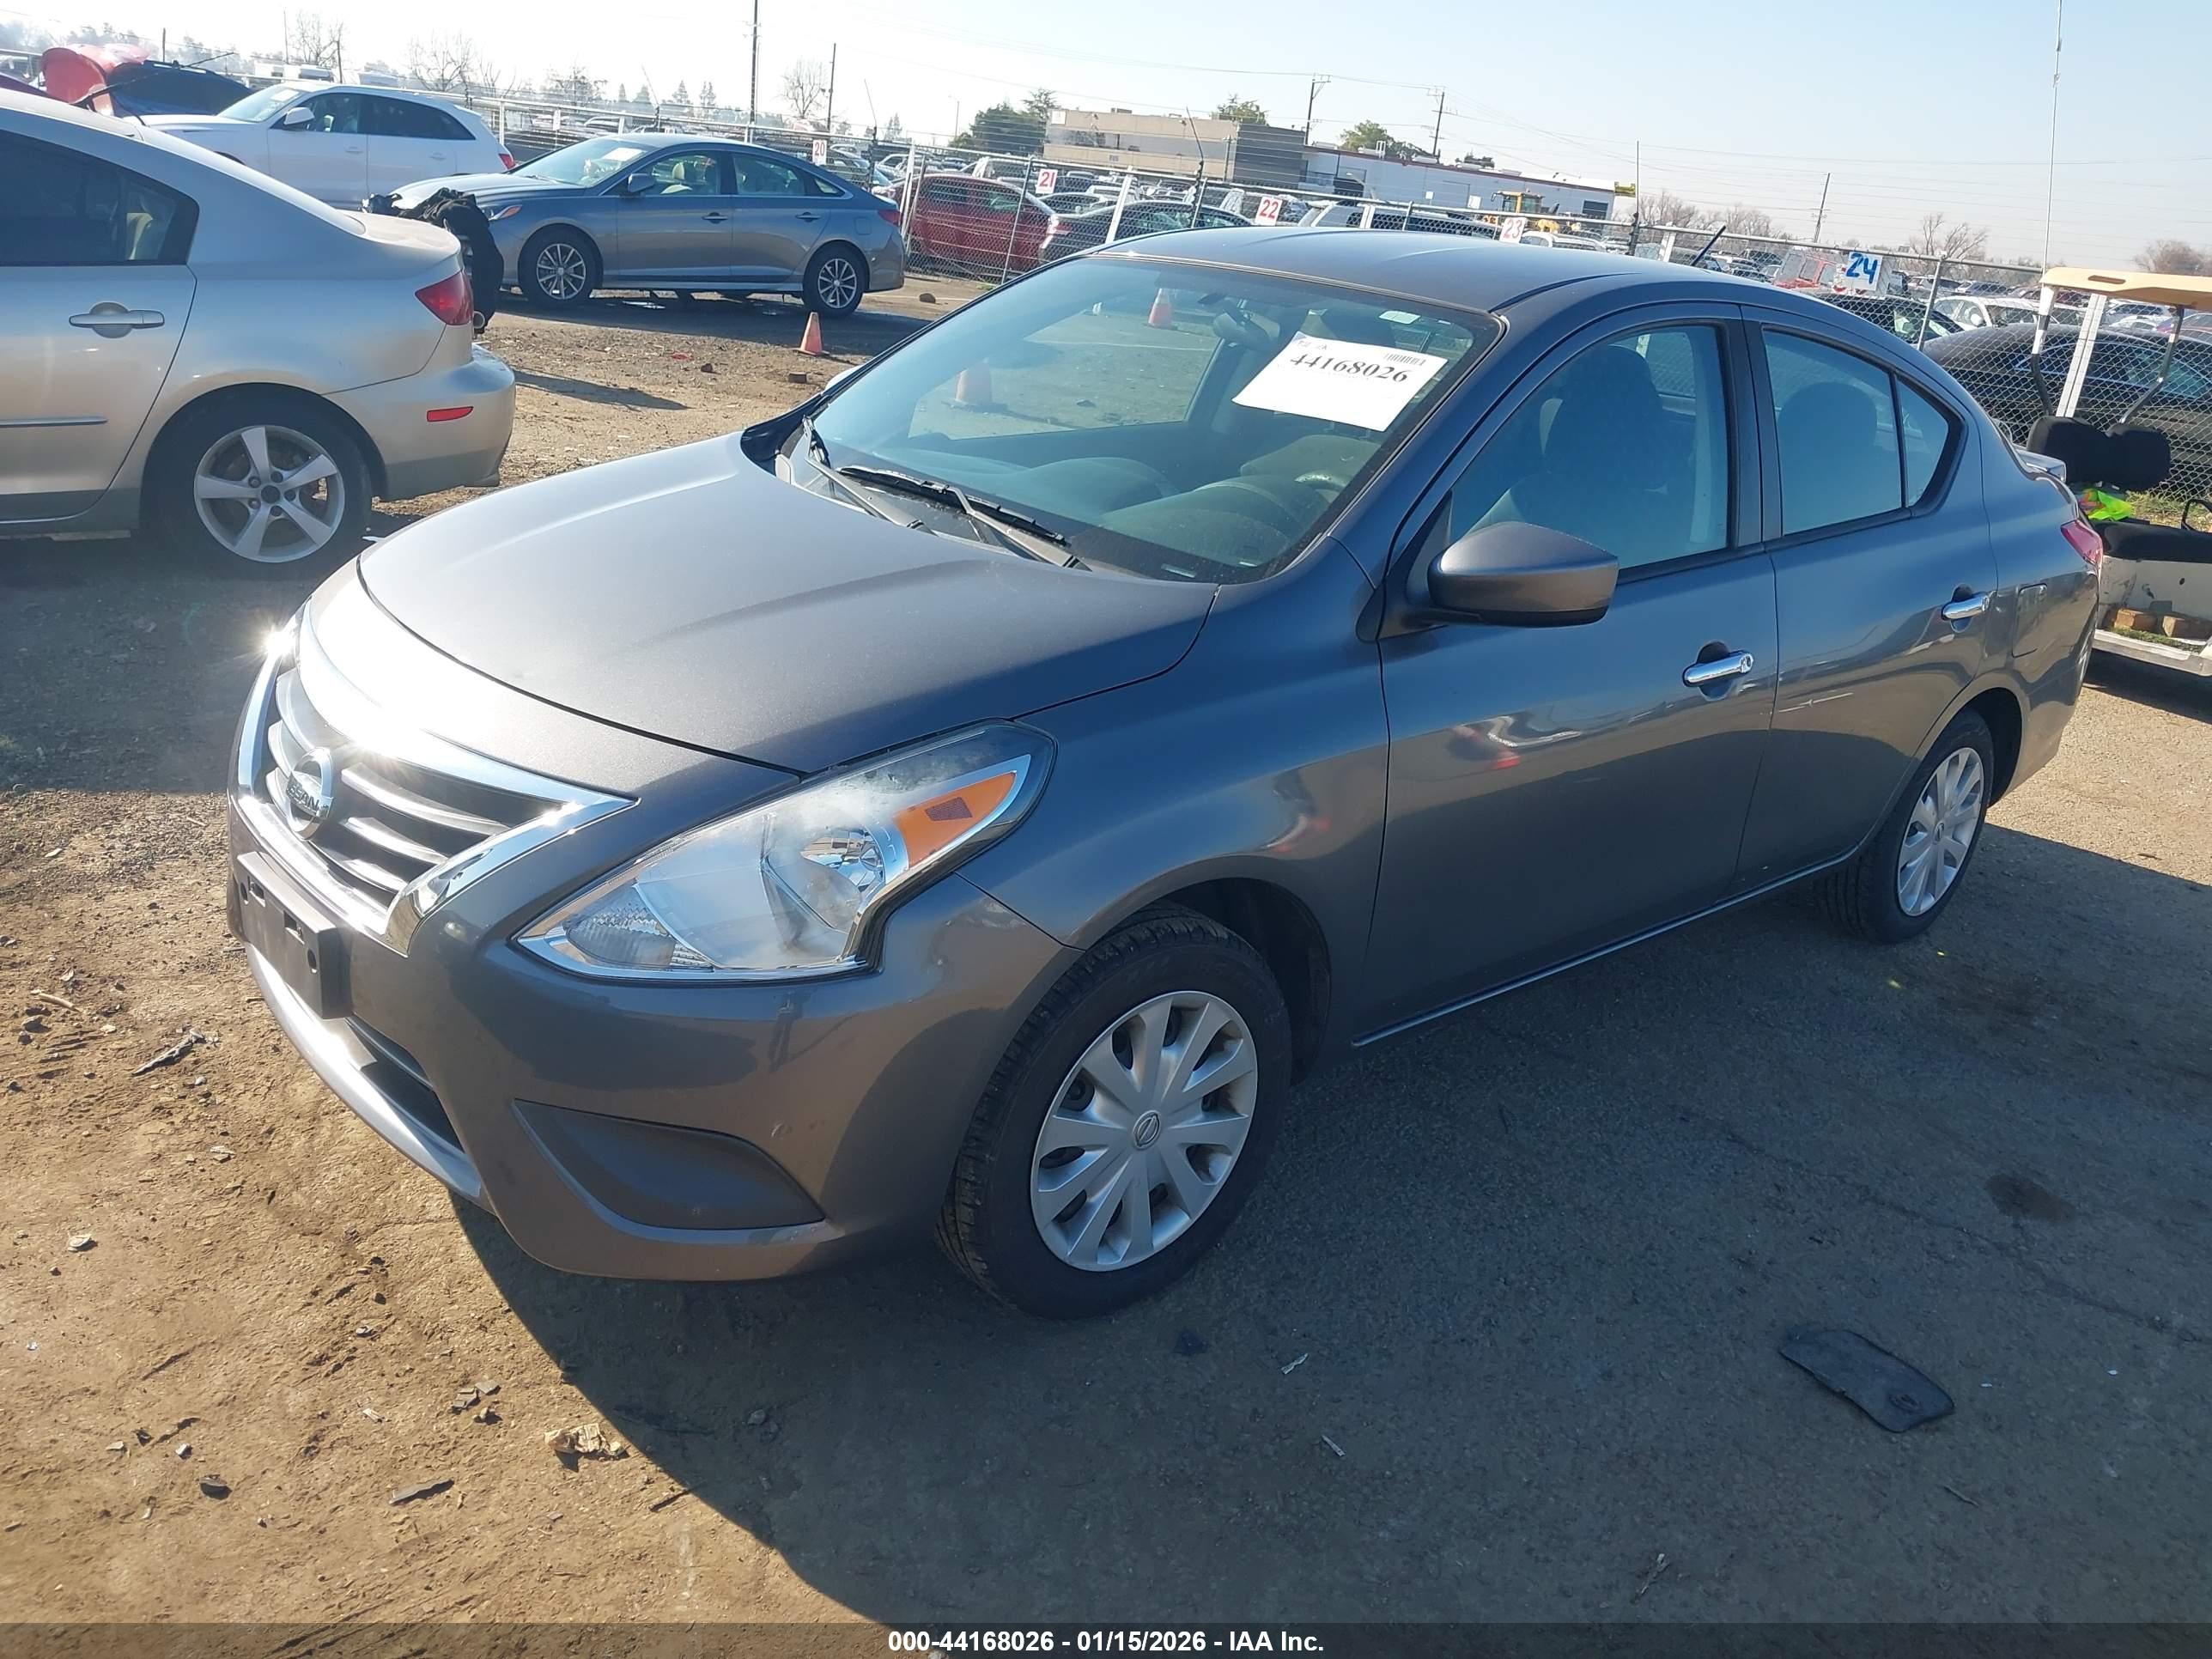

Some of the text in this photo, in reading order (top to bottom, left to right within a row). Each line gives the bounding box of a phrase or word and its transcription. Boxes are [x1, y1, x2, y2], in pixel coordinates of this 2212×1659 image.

[815, 142, 825, 156] 20
[1039, 172, 1055, 187] 21
[1260, 199, 1279, 219] 22
[1504, 218, 1522, 239] 23
[1846, 252, 1878, 284] 24
[1290, 353, 1412, 383] 44168026
